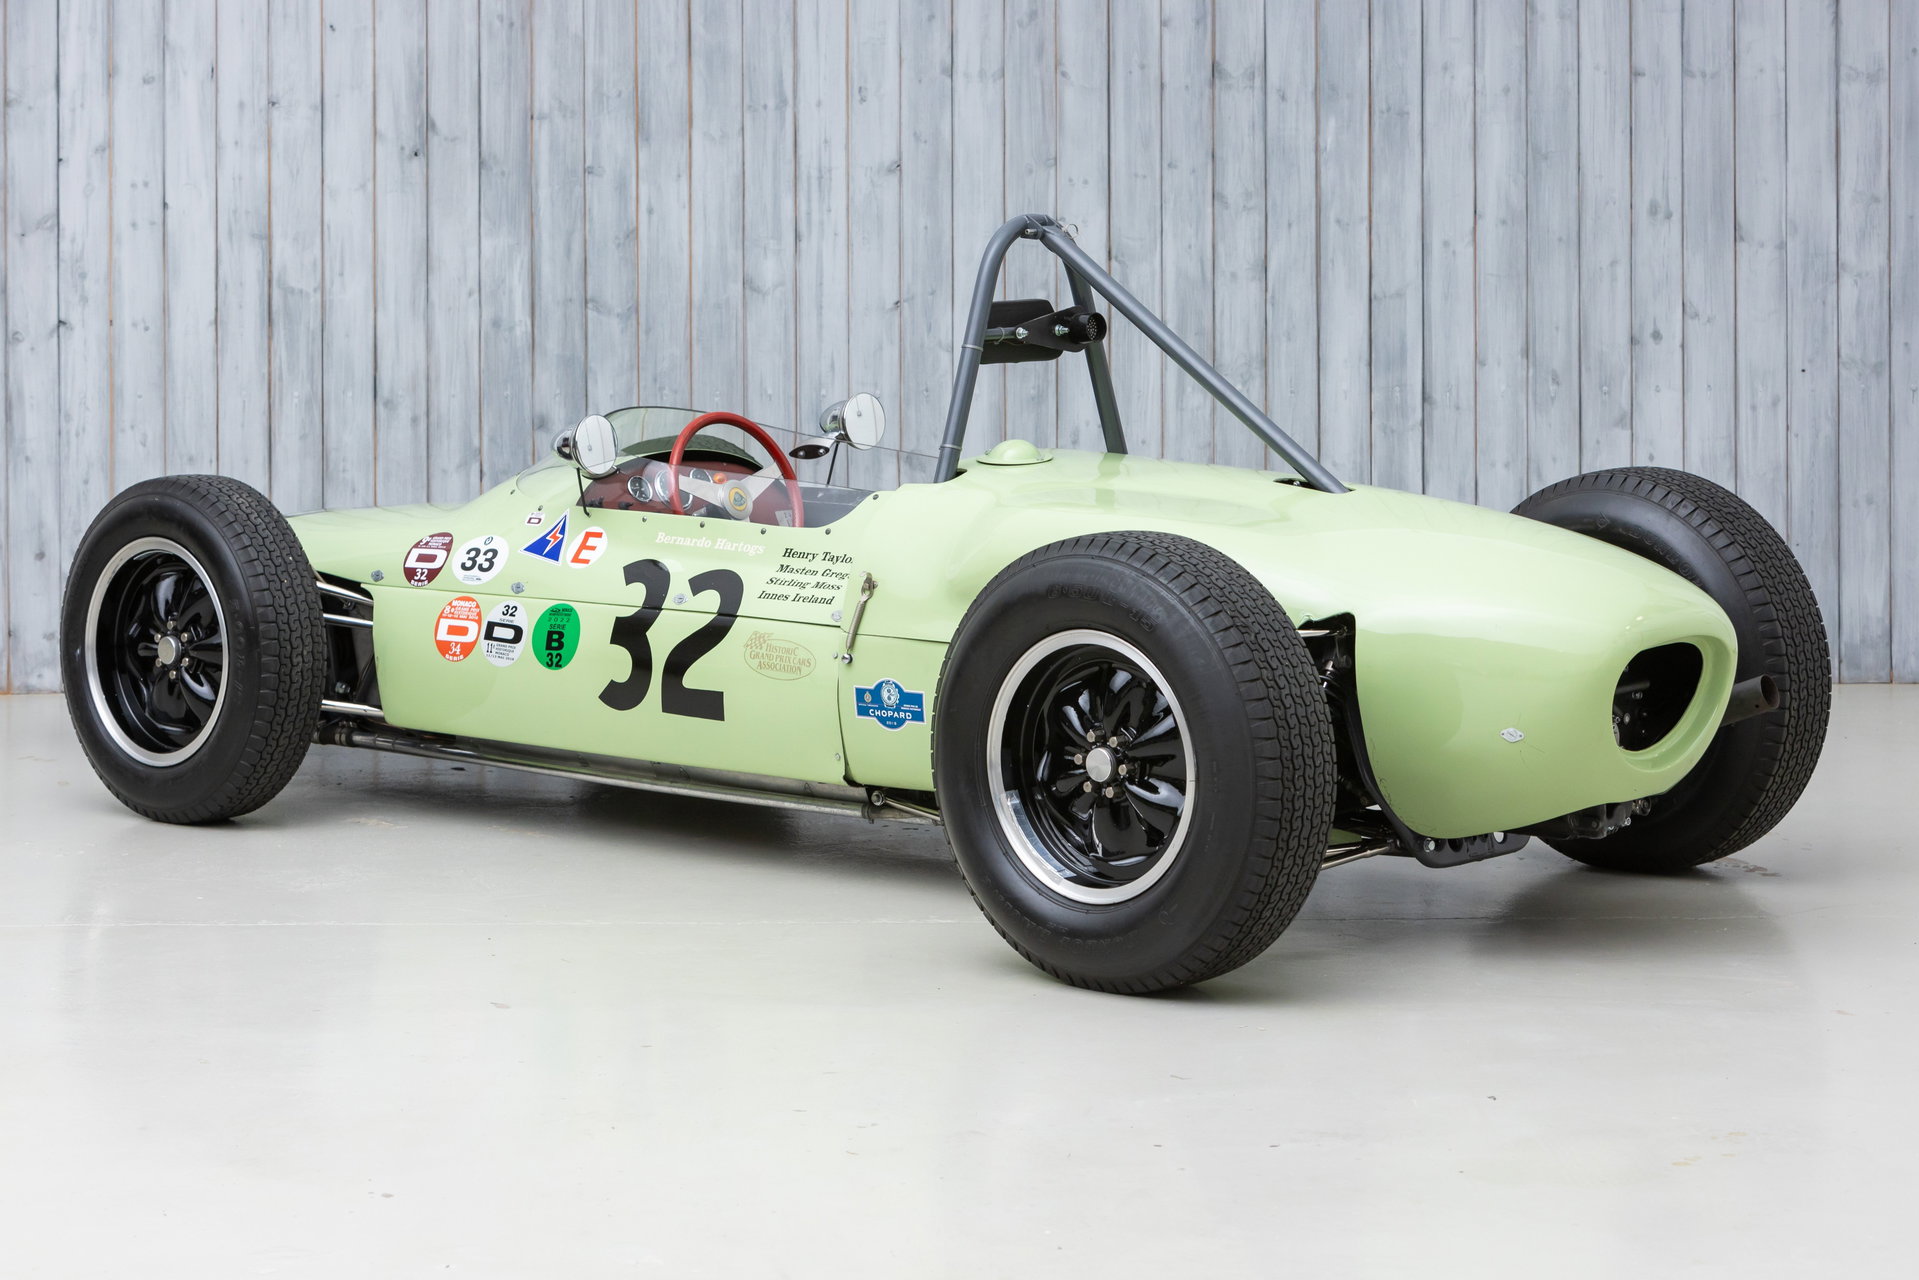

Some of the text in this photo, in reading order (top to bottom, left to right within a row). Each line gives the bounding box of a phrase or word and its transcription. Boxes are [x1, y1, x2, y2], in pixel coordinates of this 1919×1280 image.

[570, 531, 603, 565] E
[655, 531, 765, 557] Bernardo Hartogs
[404, 548, 448, 569] D
[461, 547, 499, 573] 33
[782, 548, 818, 563] Henry
[414, 568, 428, 580] 32
[776, 564, 819, 577] Masten
[766, 577, 843, 591] Stirling Moss
[757, 590, 835, 605] Innes Ireland
[502, 604, 518, 618] 32
[436, 618, 479, 643] D
[484, 621, 523, 644] D
[545, 630, 565, 651] B
[598, 558, 744, 721] 32
[449, 642, 461, 655] 34
[765, 643, 799, 656] HISTORIC
[546, 652, 563, 668] 32
[750, 650, 812, 668] GRAND PRIX CARS
[757, 660, 802, 675] ASSOCIATION
[869, 709, 912, 720] CHOPARD
